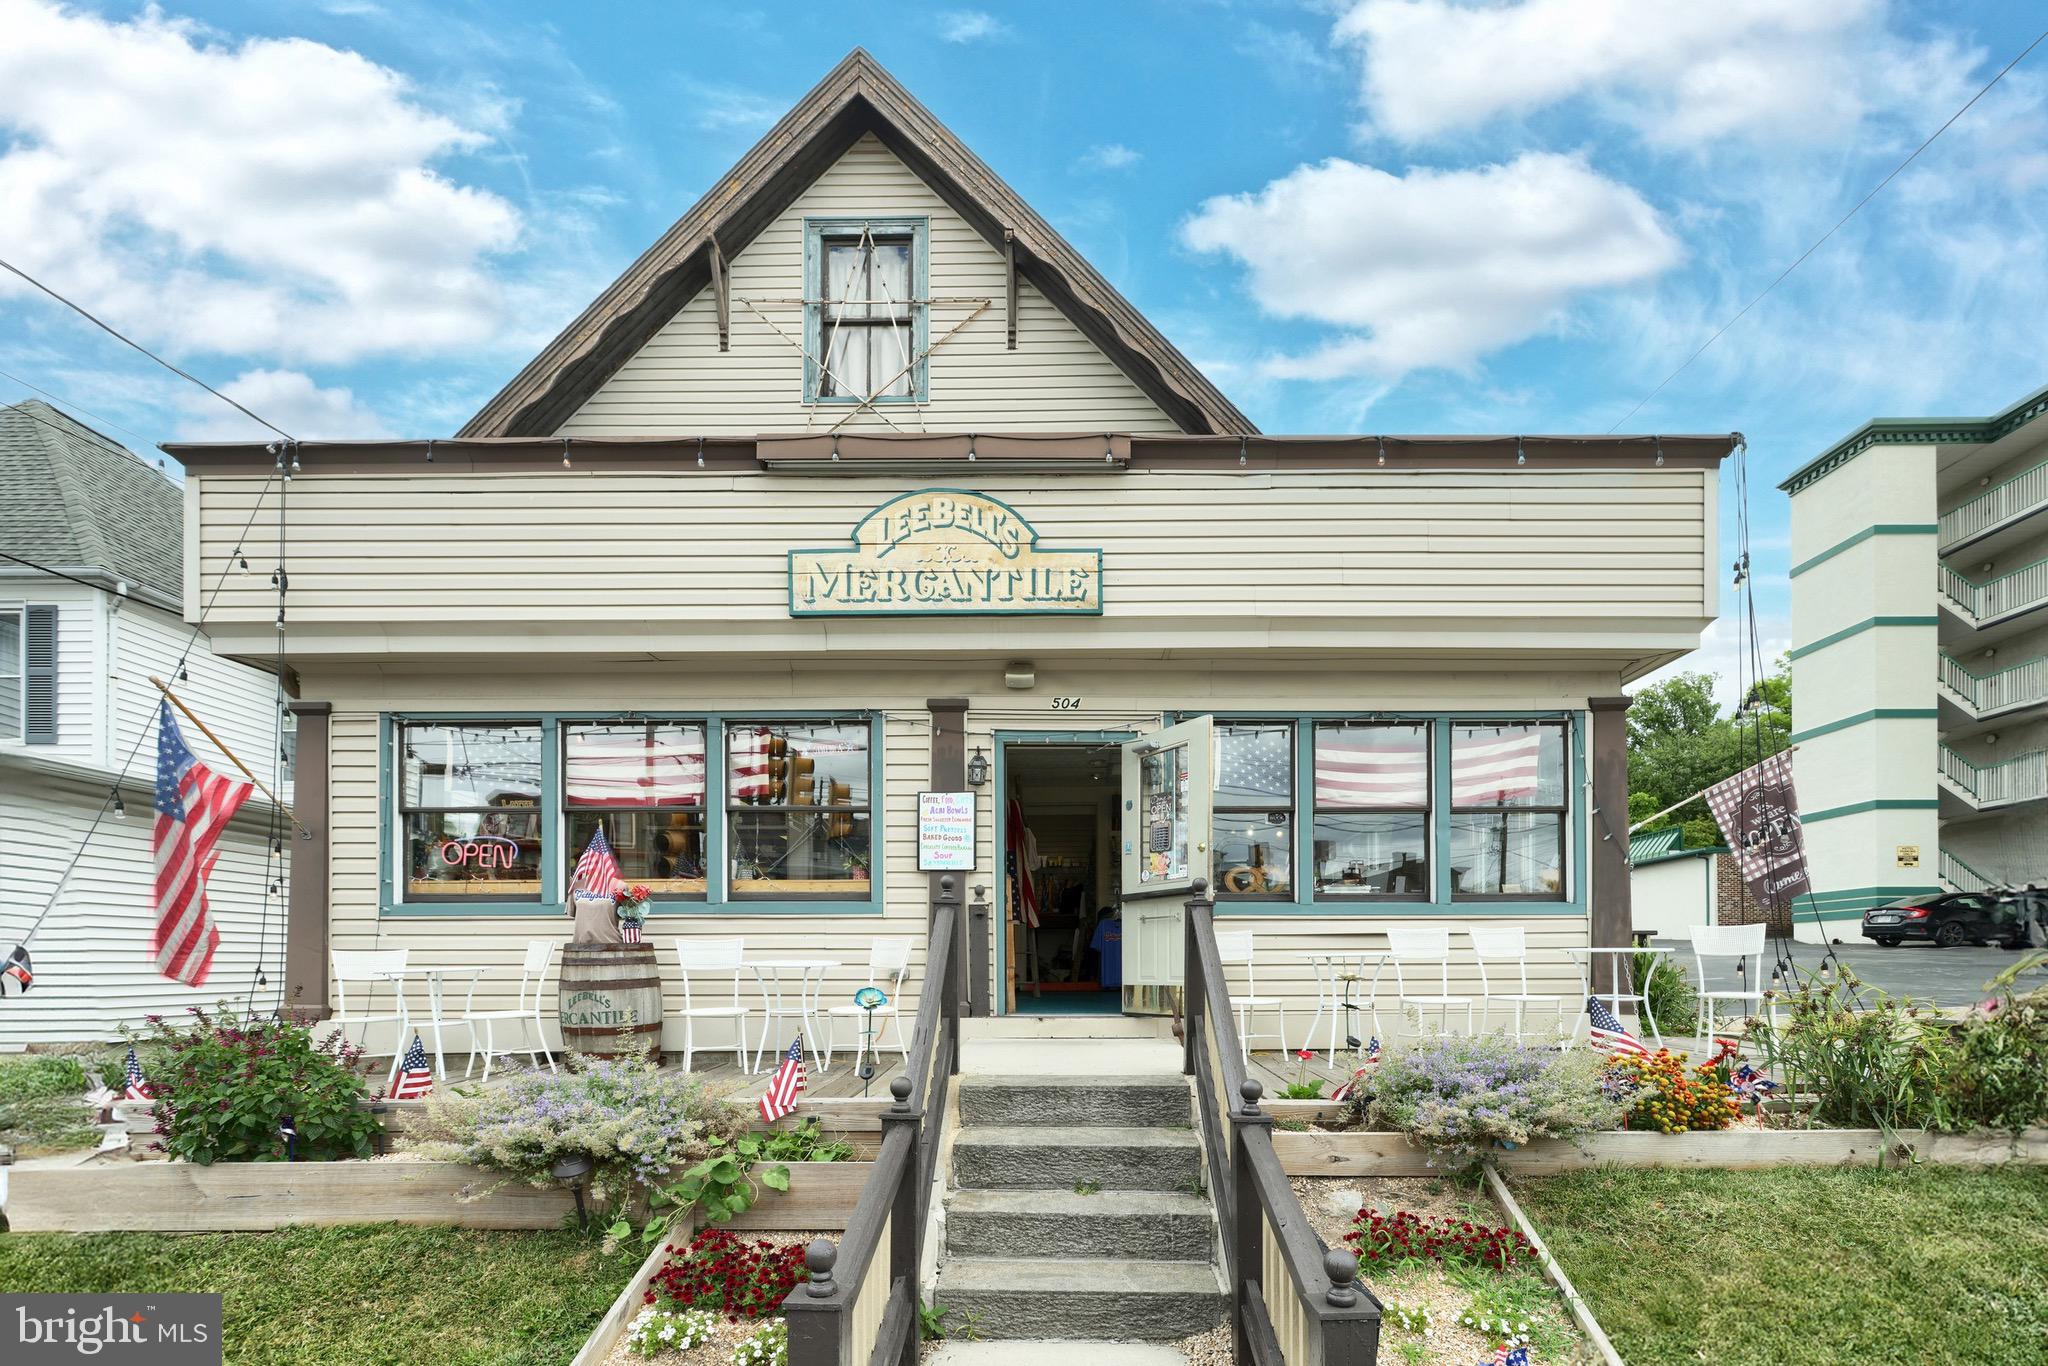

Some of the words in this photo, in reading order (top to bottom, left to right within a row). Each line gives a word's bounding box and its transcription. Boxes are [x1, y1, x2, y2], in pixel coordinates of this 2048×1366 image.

[876, 497, 1020, 560] LEEBELL'S
[803, 561, 1091, 603] MERCANTILE
[1051, 697, 1081, 709] 504
[1151, 803, 1171, 815] OPEN
[1767, 805, 1787, 819] are
[1749, 809, 1801, 846] OPEN
[943, 834, 962, 842] GOODS
[441, 841, 514, 869] OPEN
[574, 889, 616, 903] Gettysrg
[568, 992, 611, 1009] LEEBELL'S
[560, 1009, 639, 1026] ERCANTILE
